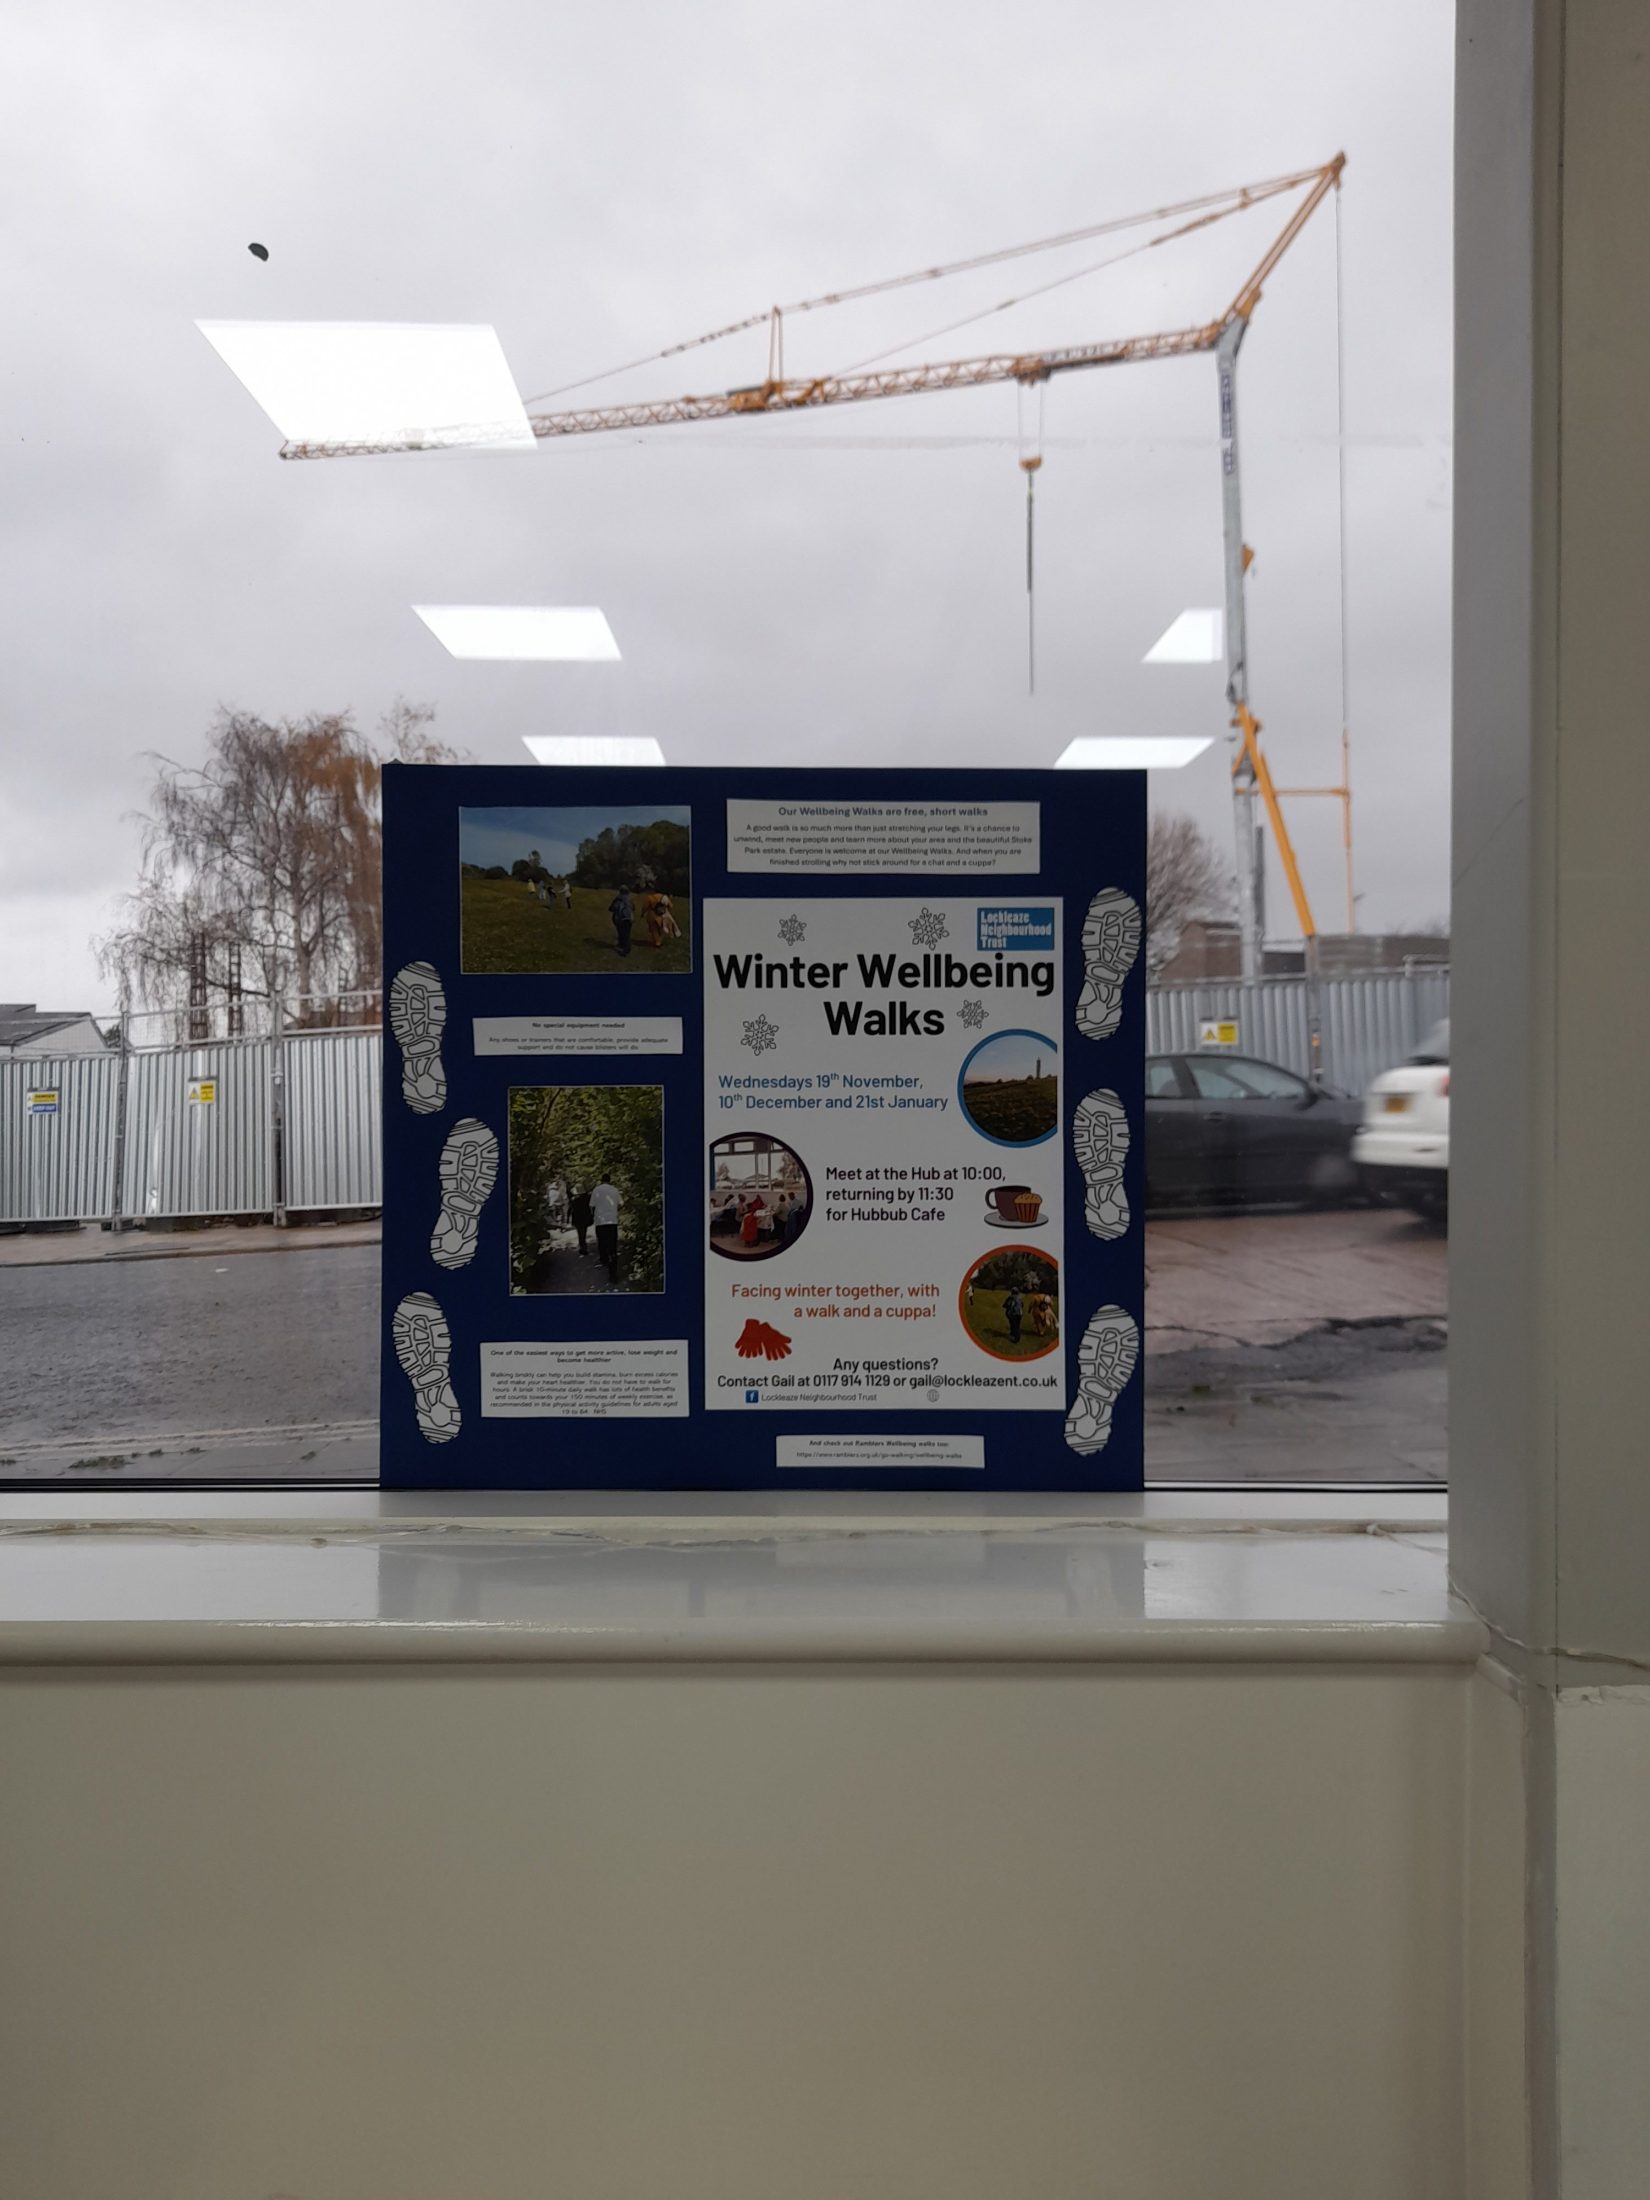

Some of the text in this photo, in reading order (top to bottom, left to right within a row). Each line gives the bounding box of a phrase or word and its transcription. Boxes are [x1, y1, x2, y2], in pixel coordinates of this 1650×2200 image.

[779, 807, 797, 816] Our
[800, 807, 850, 818] Wellbeing
[852, 807, 883, 816] Walks
[904, 807, 927, 817] free,
[930, 807, 956, 816] short
[959, 807, 988, 816] walks
[770, 858, 800, 866] finished
[801, 859, 831, 867] strolling
[832, 859, 847, 867] why
[968, 859, 996, 867] cuppa?
[980, 911, 1030, 923] Lockleaze
[980, 922, 1052, 937] Neighbourhood
[980, 936, 1007, 948] Trust
[713, 952, 1055, 997] Winter Wellbeing
[823, 1001, 945, 1036] Walks
[718, 1075, 813, 1092] Wednesdays
[843, 1074, 923, 1089] November,
[746, 1095, 823, 1109] December
[825, 1095, 852, 1109] and
[856, 1095, 885, 1109] 21st
[888, 1095, 948, 1112] January
[826, 1166, 1006, 1182] Meet at the Hub at 10:00,
[826, 1187, 954, 1204] returning by 11:30
[826, 1207, 945, 1221] for Hubbub Cafe
[732, 1283, 940, 1301] Facing winter together, with
[794, 1304, 936, 1321] a walk and a cuppa!
[833, 1357, 939, 1374] Any questions?
[717, 1374, 1058, 1390] Contact Gail at 0117 914 1129 or gail@lockleazent.co.uk
